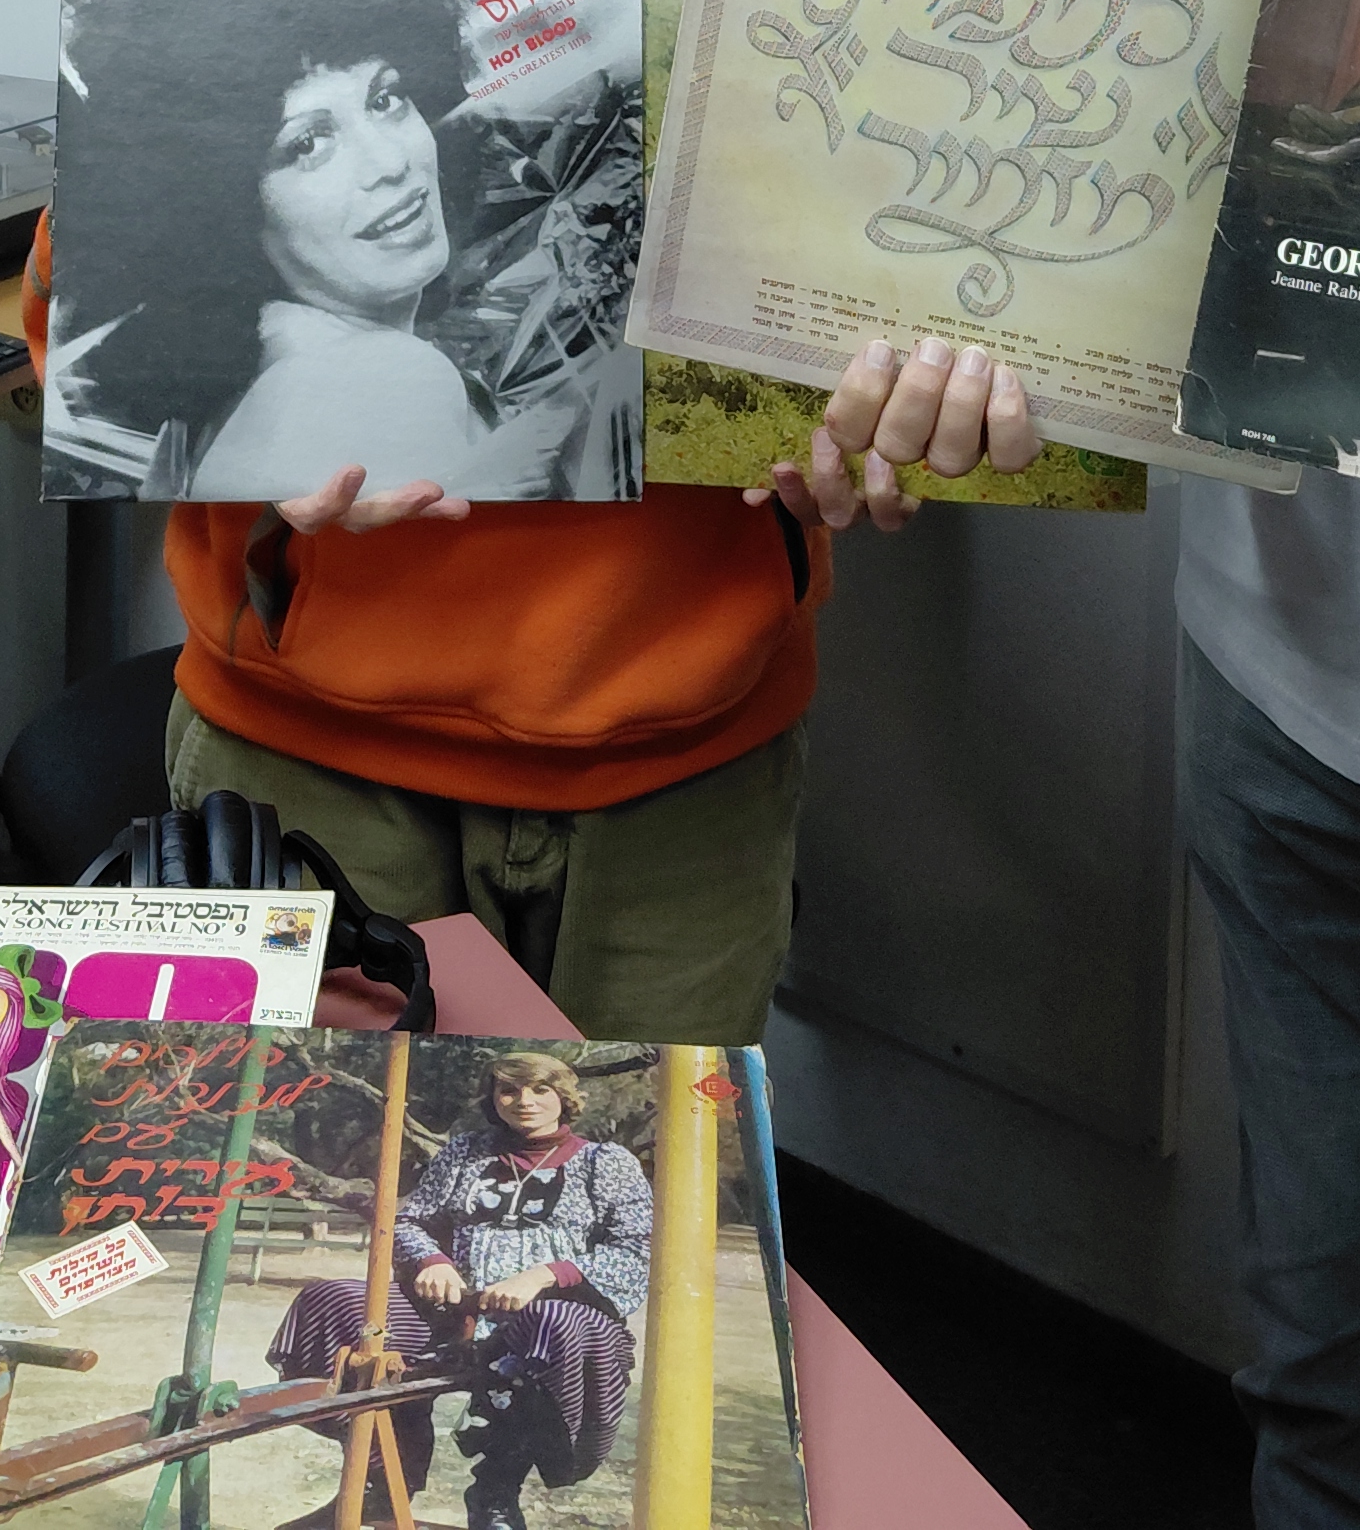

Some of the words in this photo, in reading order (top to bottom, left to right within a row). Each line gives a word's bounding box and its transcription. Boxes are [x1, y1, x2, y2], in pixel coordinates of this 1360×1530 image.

[488, 44, 522, 71] HOT
[525, 16, 576, 52] BLOOD
[470, 71, 519, 102] SHERRY'S
[518, 44, 568, 78] GREATEST
[567, 32, 593, 51] HITS
[886, 27, 1133, 148] שיר
[1271, 271, 1323, 293] Jeanne
[1241, 428, 1260, 440] ROH
[2, 892, 120, 918] הישראלי
[130, 894, 250, 921] הפסטיבל
[15, 916, 73, 931] SONG
[80, 918, 183, 934] FESTIVAL
[234, 923, 247, 936] 9
[80, 1118, 188, 1149] עם
[71, 1156, 294, 1198] עירית
[59, 1185, 225, 1236] דותן
[105, 1238, 127, 1254] כל
[46, 1250, 98, 1281] מילות
[59, 1251, 125, 1288] השירים
[60, 1258, 136, 1299] מצורפות
